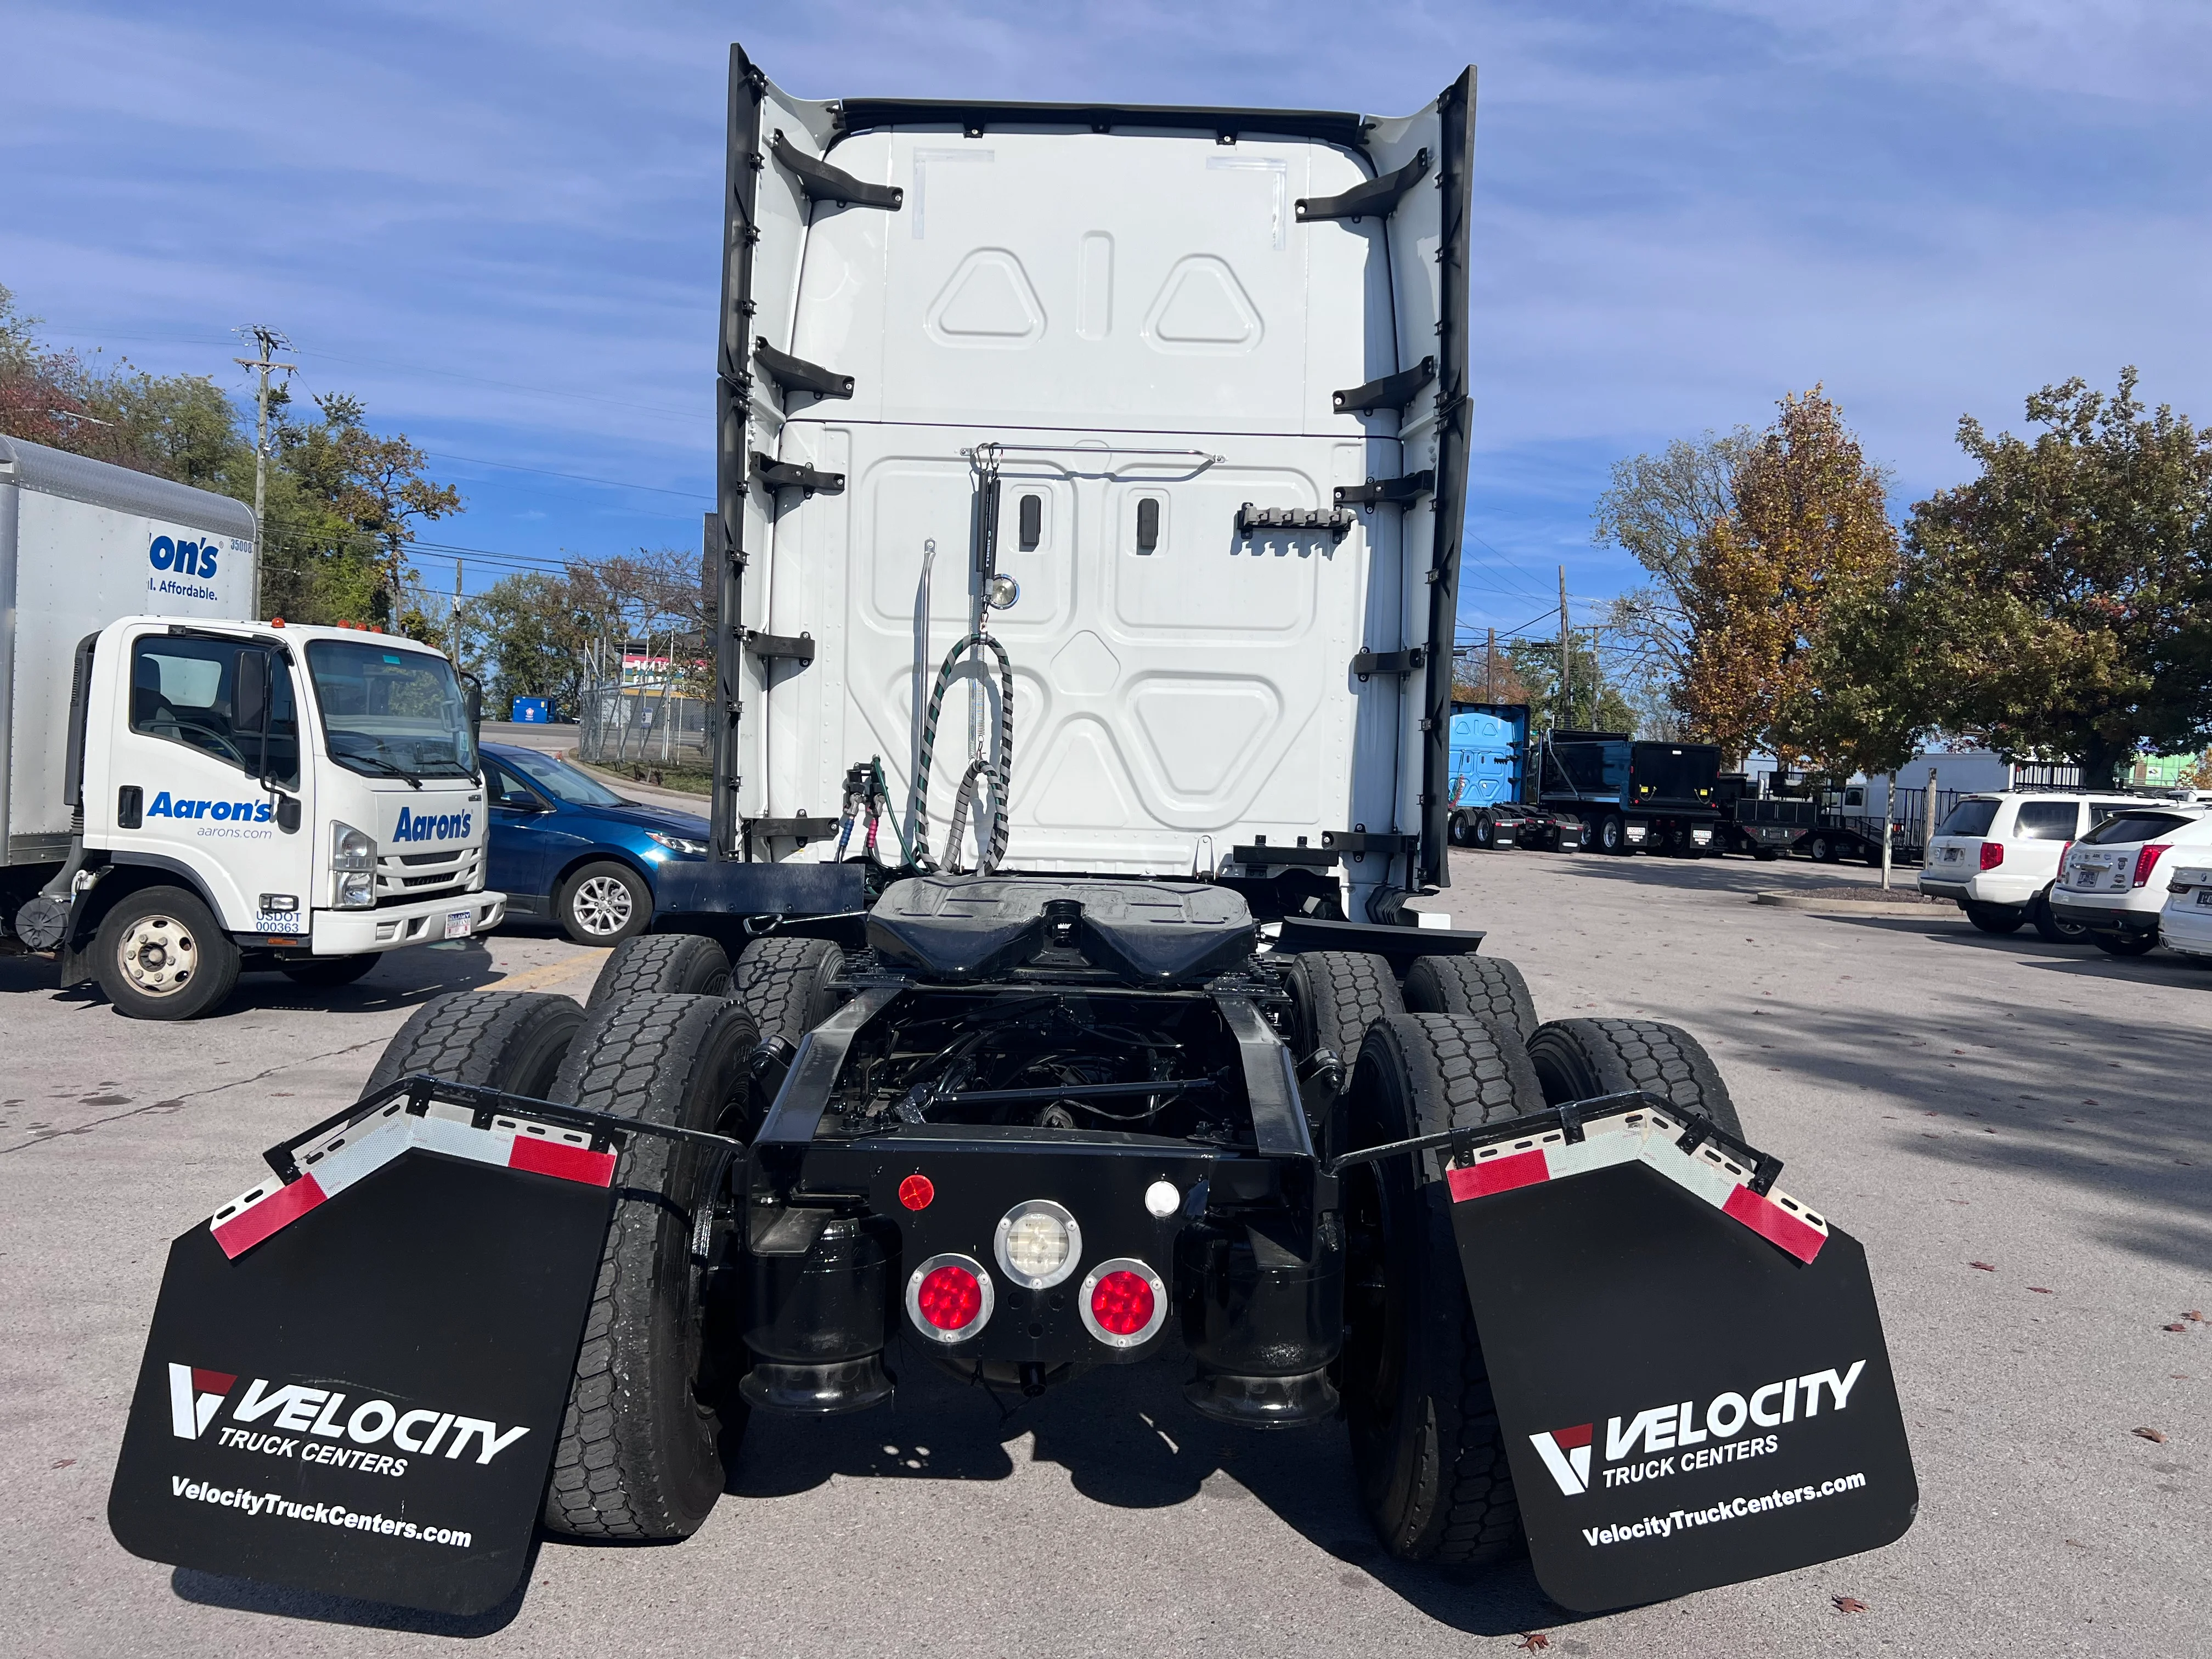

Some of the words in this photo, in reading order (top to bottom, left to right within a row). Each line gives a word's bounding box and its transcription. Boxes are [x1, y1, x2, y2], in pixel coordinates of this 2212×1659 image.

[230, 539, 252, 554] 35008
[159, 580, 217, 601] Affordable.
[146, 791, 272, 823] Aaron's
[392, 806, 472, 843] Aaron's
[197, 827, 272, 839] aarons.com
[256, 911, 301, 922] USDOT
[256, 922, 299, 933] 000363
[233, 1378, 531, 1465] VELOCITY
[1605, 1359, 1867, 1462] VELOCITY
[218, 1427, 299, 1459] TRUCK
[301, 1441, 408, 1477] CENTERS
[1602, 1456, 1675, 1488] TRUCK
[1680, 1434, 1778, 1472] CENTERS
[171, 1475, 472, 1548] VelocityTruckCenters.com
[1583, 1471, 1866, 1547] VelocityTruckCenters.com
